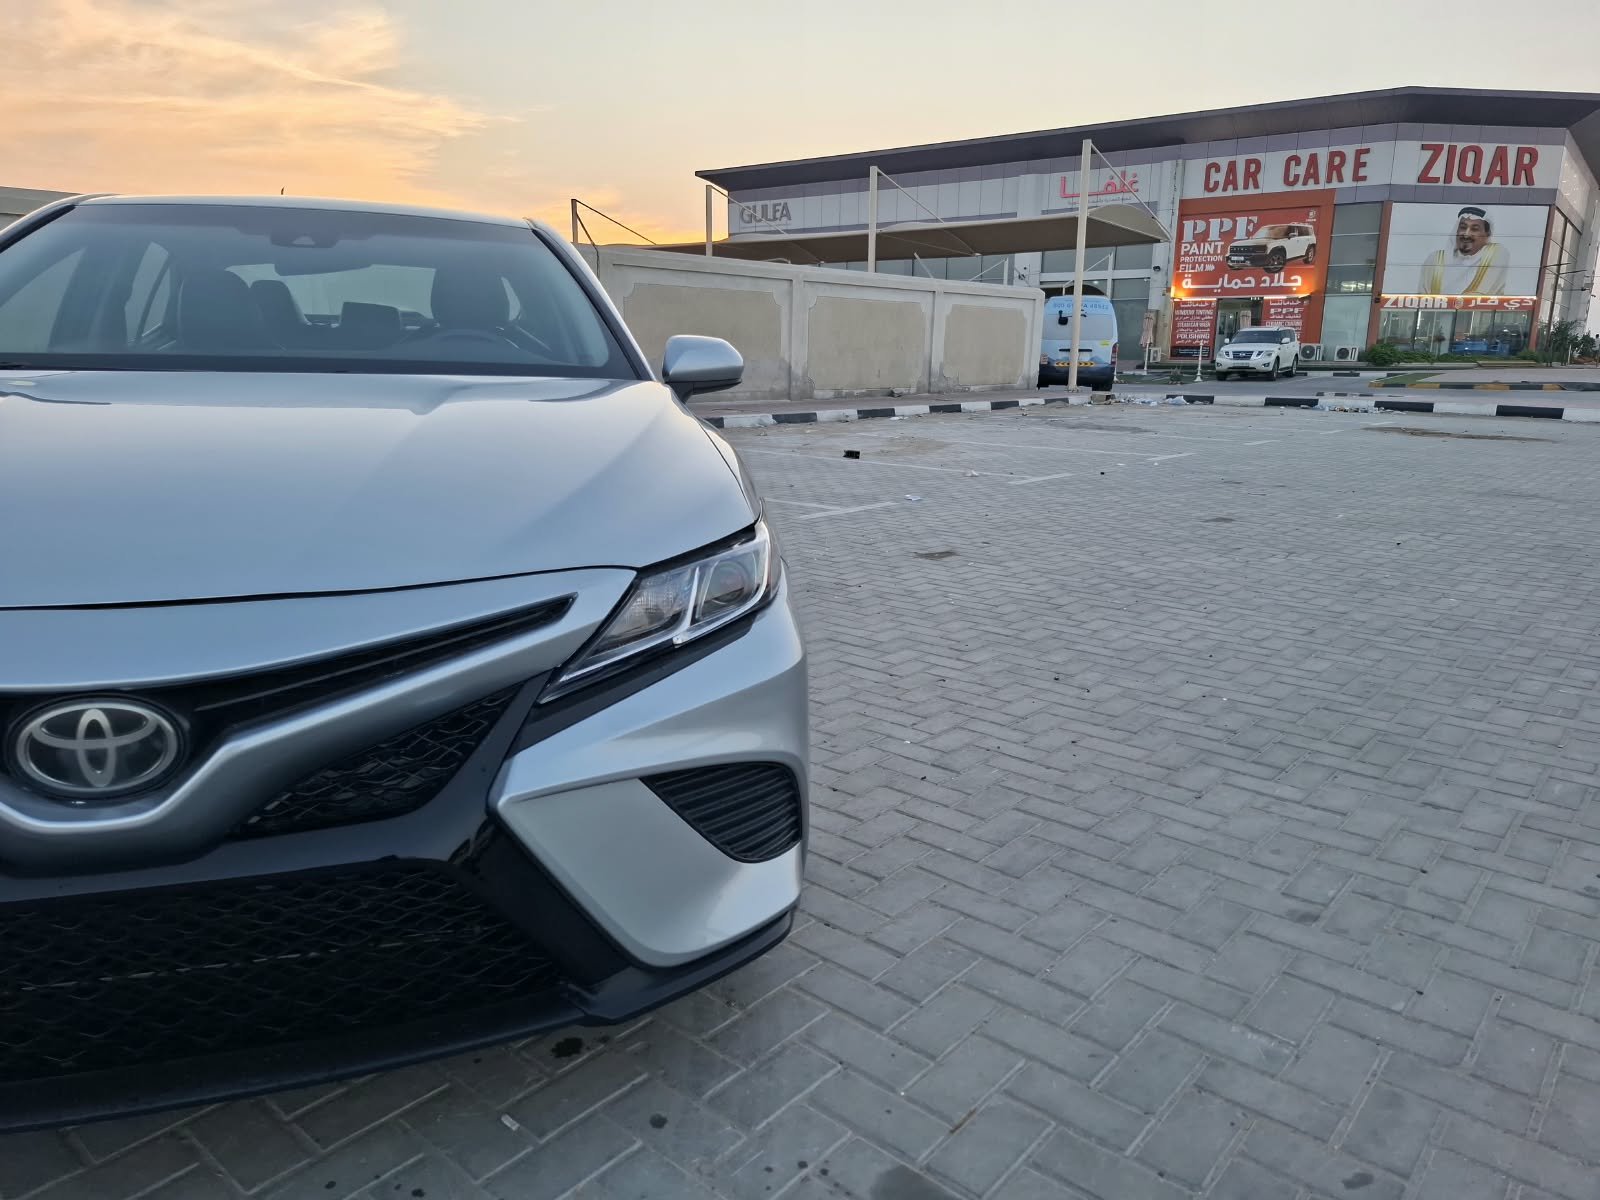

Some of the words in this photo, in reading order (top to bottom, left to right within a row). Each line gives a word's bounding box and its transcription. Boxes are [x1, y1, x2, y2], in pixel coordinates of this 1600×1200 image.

[1204, 158, 1262, 192] CAR
[1283, 148, 1371, 187] CARE
[1418, 143, 1539, 186] ZIQAR
[741, 202, 792, 223] GULFA
[1182, 216, 1258, 242] PPF
[1180, 241, 1224, 255] PAINT
[1180, 255, 1223, 263] PROTECTION
[1179, 264, 1204, 272] FILM
[1384, 297, 1448, 309] ZIQAR
